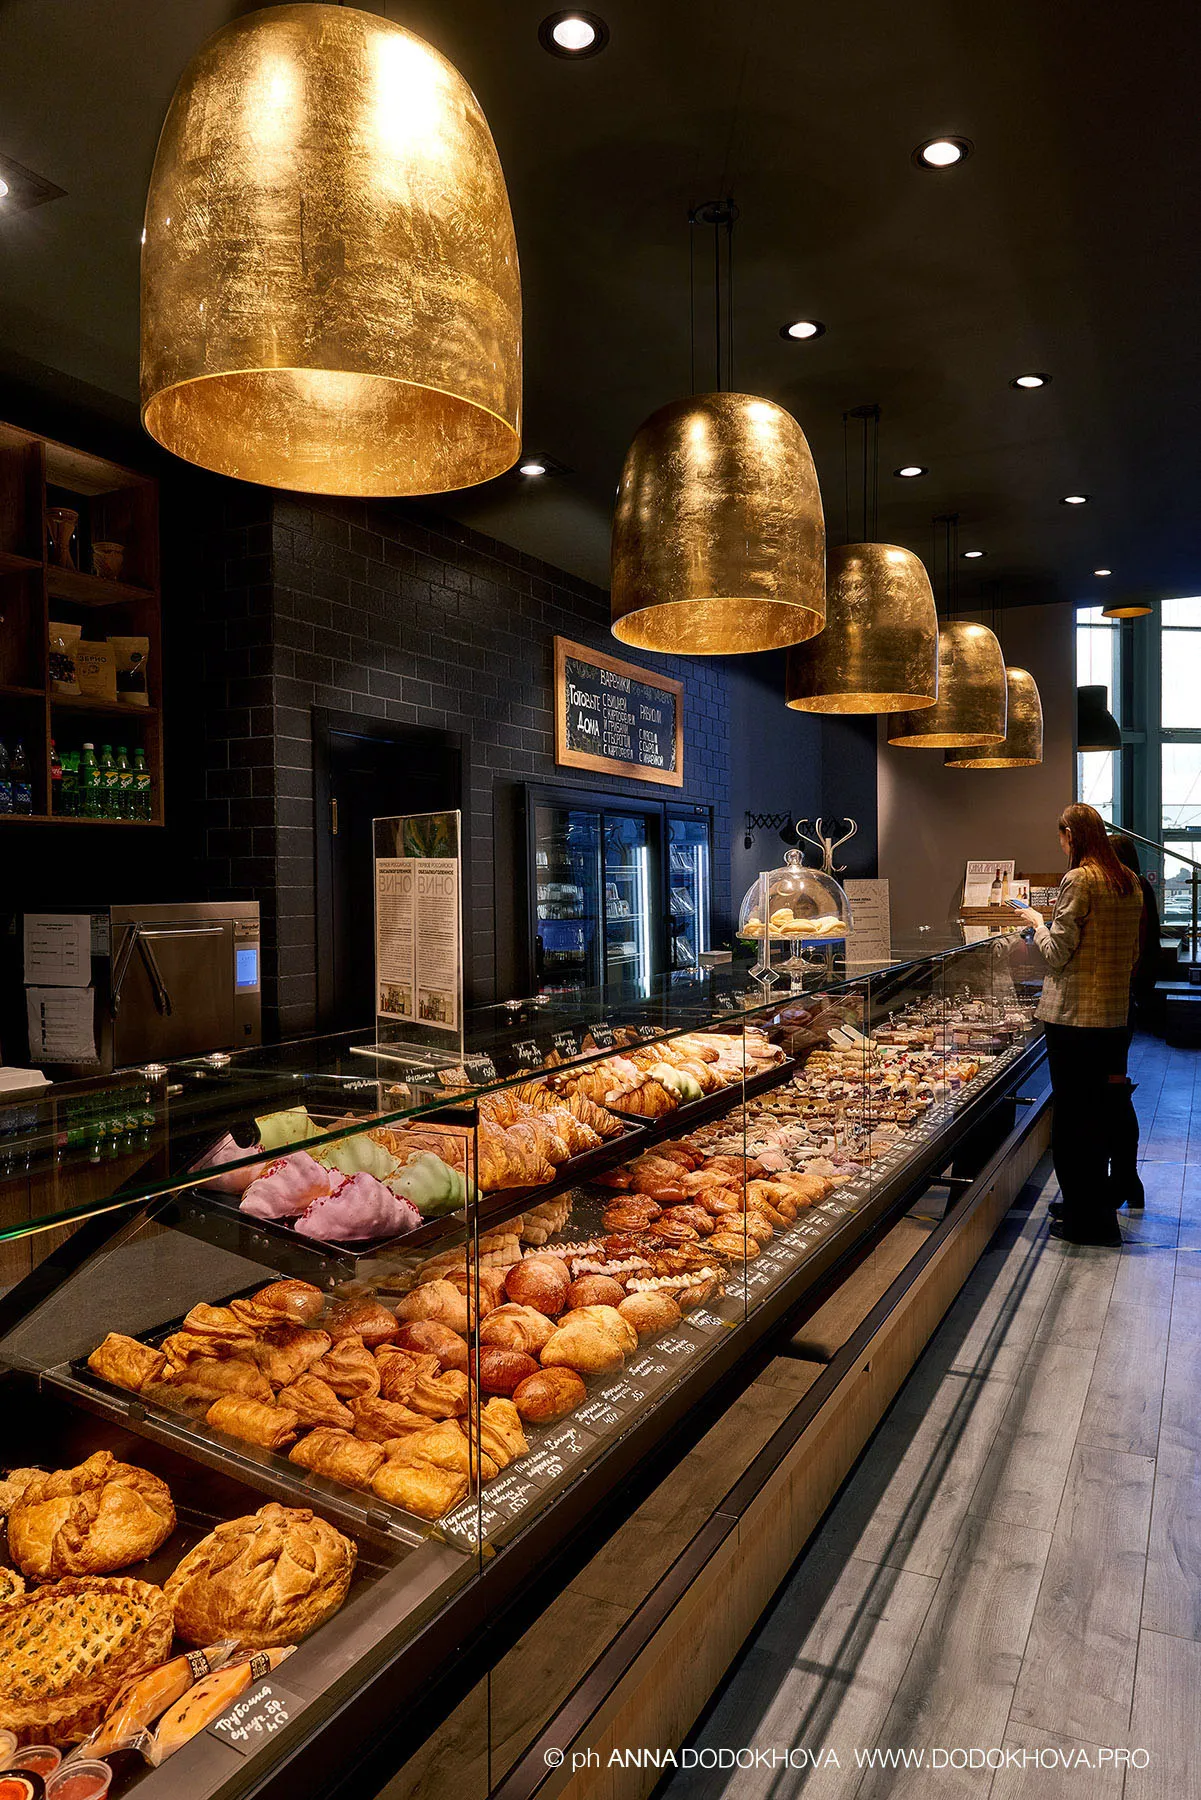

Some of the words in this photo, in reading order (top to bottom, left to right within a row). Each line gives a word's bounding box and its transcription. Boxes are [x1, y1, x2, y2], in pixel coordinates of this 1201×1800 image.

[577, 711, 600, 737] ДОМА
[379, 875, 412, 893] ВИНО
[418, 876, 454, 895] ВИНО
